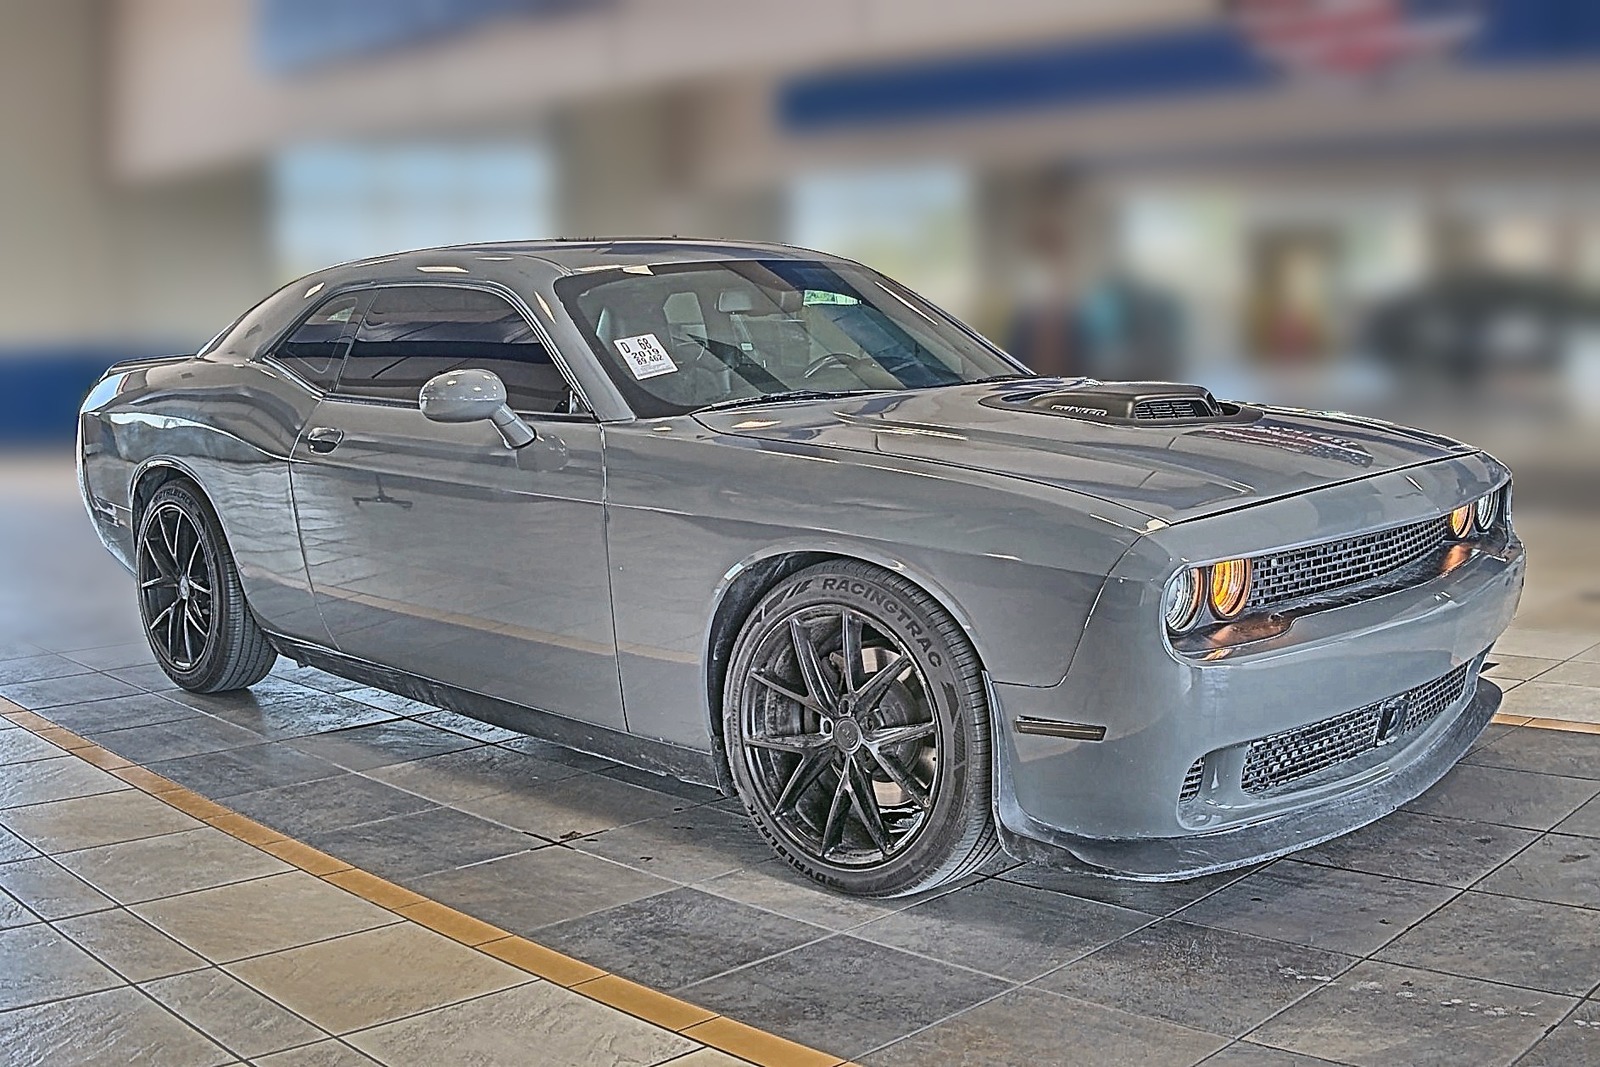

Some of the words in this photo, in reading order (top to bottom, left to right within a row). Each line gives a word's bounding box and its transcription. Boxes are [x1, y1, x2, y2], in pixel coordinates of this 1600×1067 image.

[620, 342, 631, 353] D
[637, 337, 652, 350] 68
[632, 348, 660, 359] 2019
[822, 578, 943, 668] RACINGTRAC
